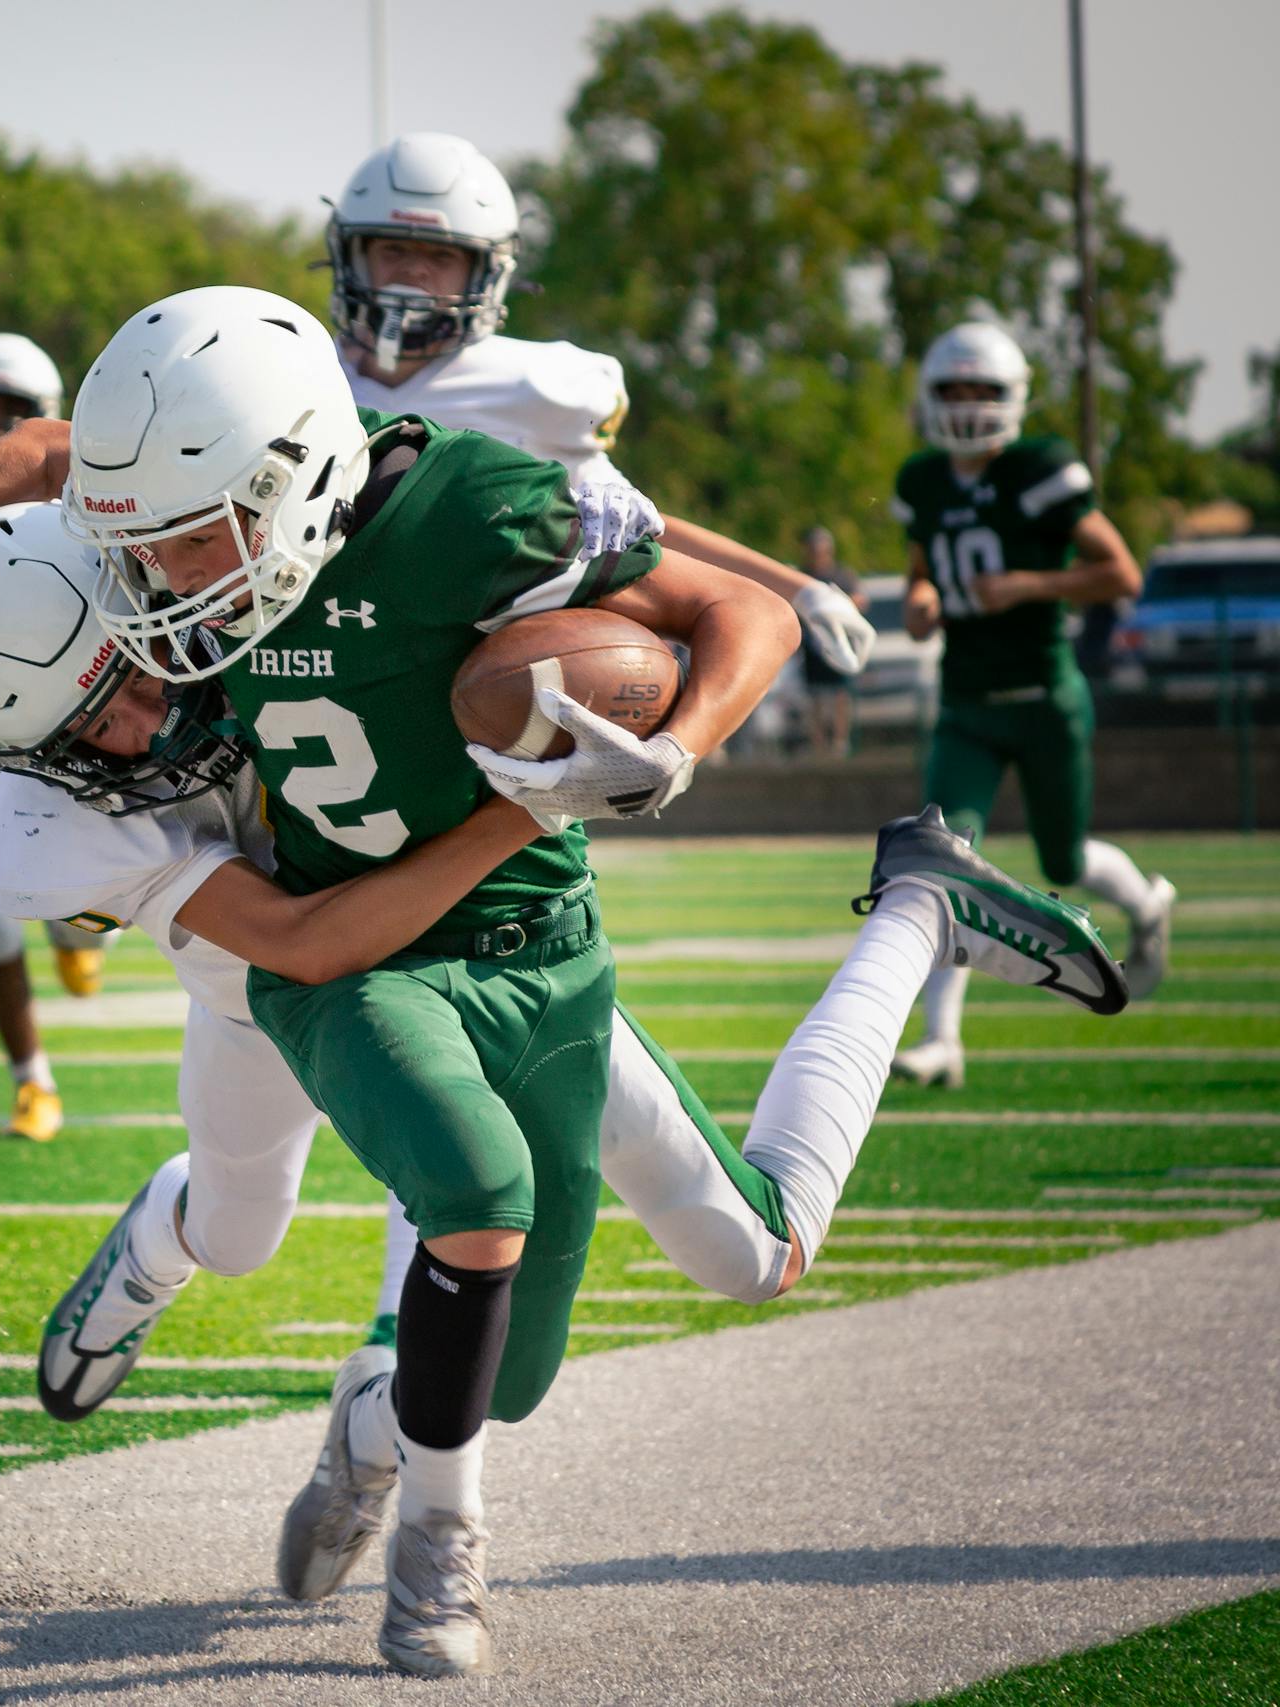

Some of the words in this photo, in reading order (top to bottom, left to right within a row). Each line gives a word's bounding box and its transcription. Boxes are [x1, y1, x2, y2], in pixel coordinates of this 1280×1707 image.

[84, 496, 136, 514] Riddell
[931, 525, 1005, 617] 10
[77, 637, 119, 690] Ridde
[249, 648, 335, 677] IRISH
[613, 683, 661, 702] GST
[253, 695, 412, 858] 2
